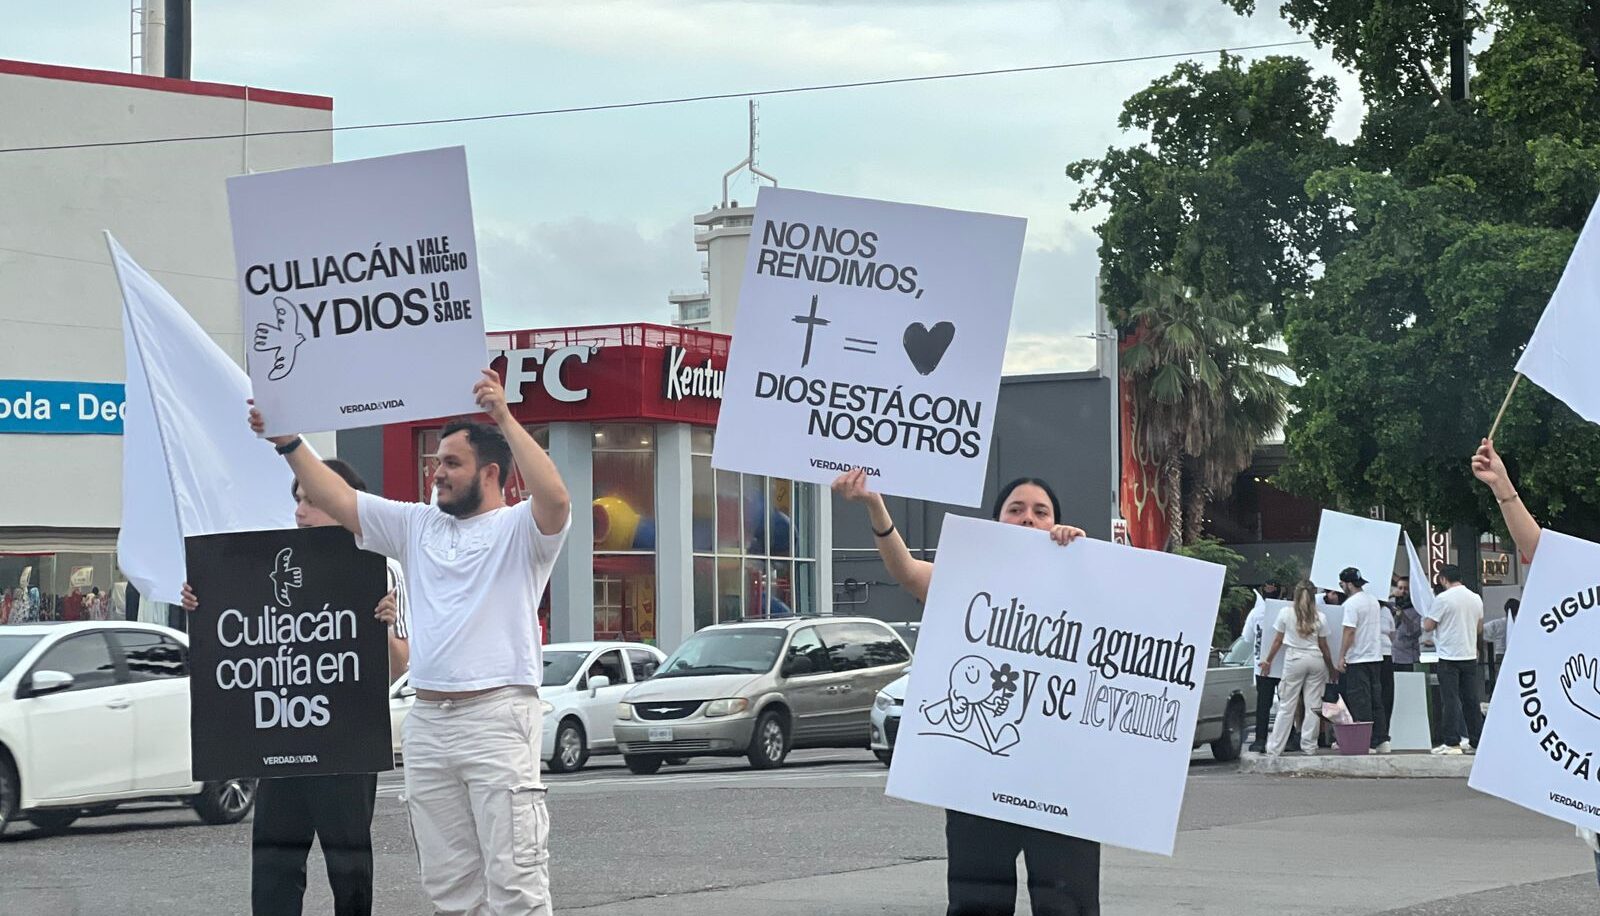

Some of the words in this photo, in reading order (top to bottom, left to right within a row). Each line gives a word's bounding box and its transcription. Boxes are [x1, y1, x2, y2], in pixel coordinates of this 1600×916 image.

[416, 236, 450, 257] VALE
[419, 252, 467, 275] MUCHO
[762, 219, 810, 250] NO
[811, 225, 878, 259] NOS
[245, 242, 415, 296] CULIACÁN
[431, 281, 450, 302] LO
[756, 248, 925, 299] RENDIMOS,
[299, 300, 328, 338] Y
[333, 287, 429, 336] DIOS
[434, 299, 472, 323] SABE
[488, 345, 590, 403] FC
[667, 345, 724, 400] Kentu
[755, 371, 826, 406] DIOS
[829, 382, 905, 418] ESTÁ
[908, 393, 982, 428] CON
[807, 409, 981, 459] NOSOTROS
[217, 603, 357, 648] Culiacán
[964, 591, 1083, 664] Culiacán
[1086, 626, 1196, 691] aguanta,
[216, 645, 311, 690] confía
[316, 650, 359, 684] en
[254, 687, 331, 729] Dios
[1014, 669, 1041, 725] y
[1042, 675, 1076, 721] se
[1079, 670, 1182, 743] levanta
[1518, 669, 1548, 734] DIOS
[1539, 729, 1593, 781] ESTÁ
[992, 792, 1069, 817] VERDAD&VIDA
